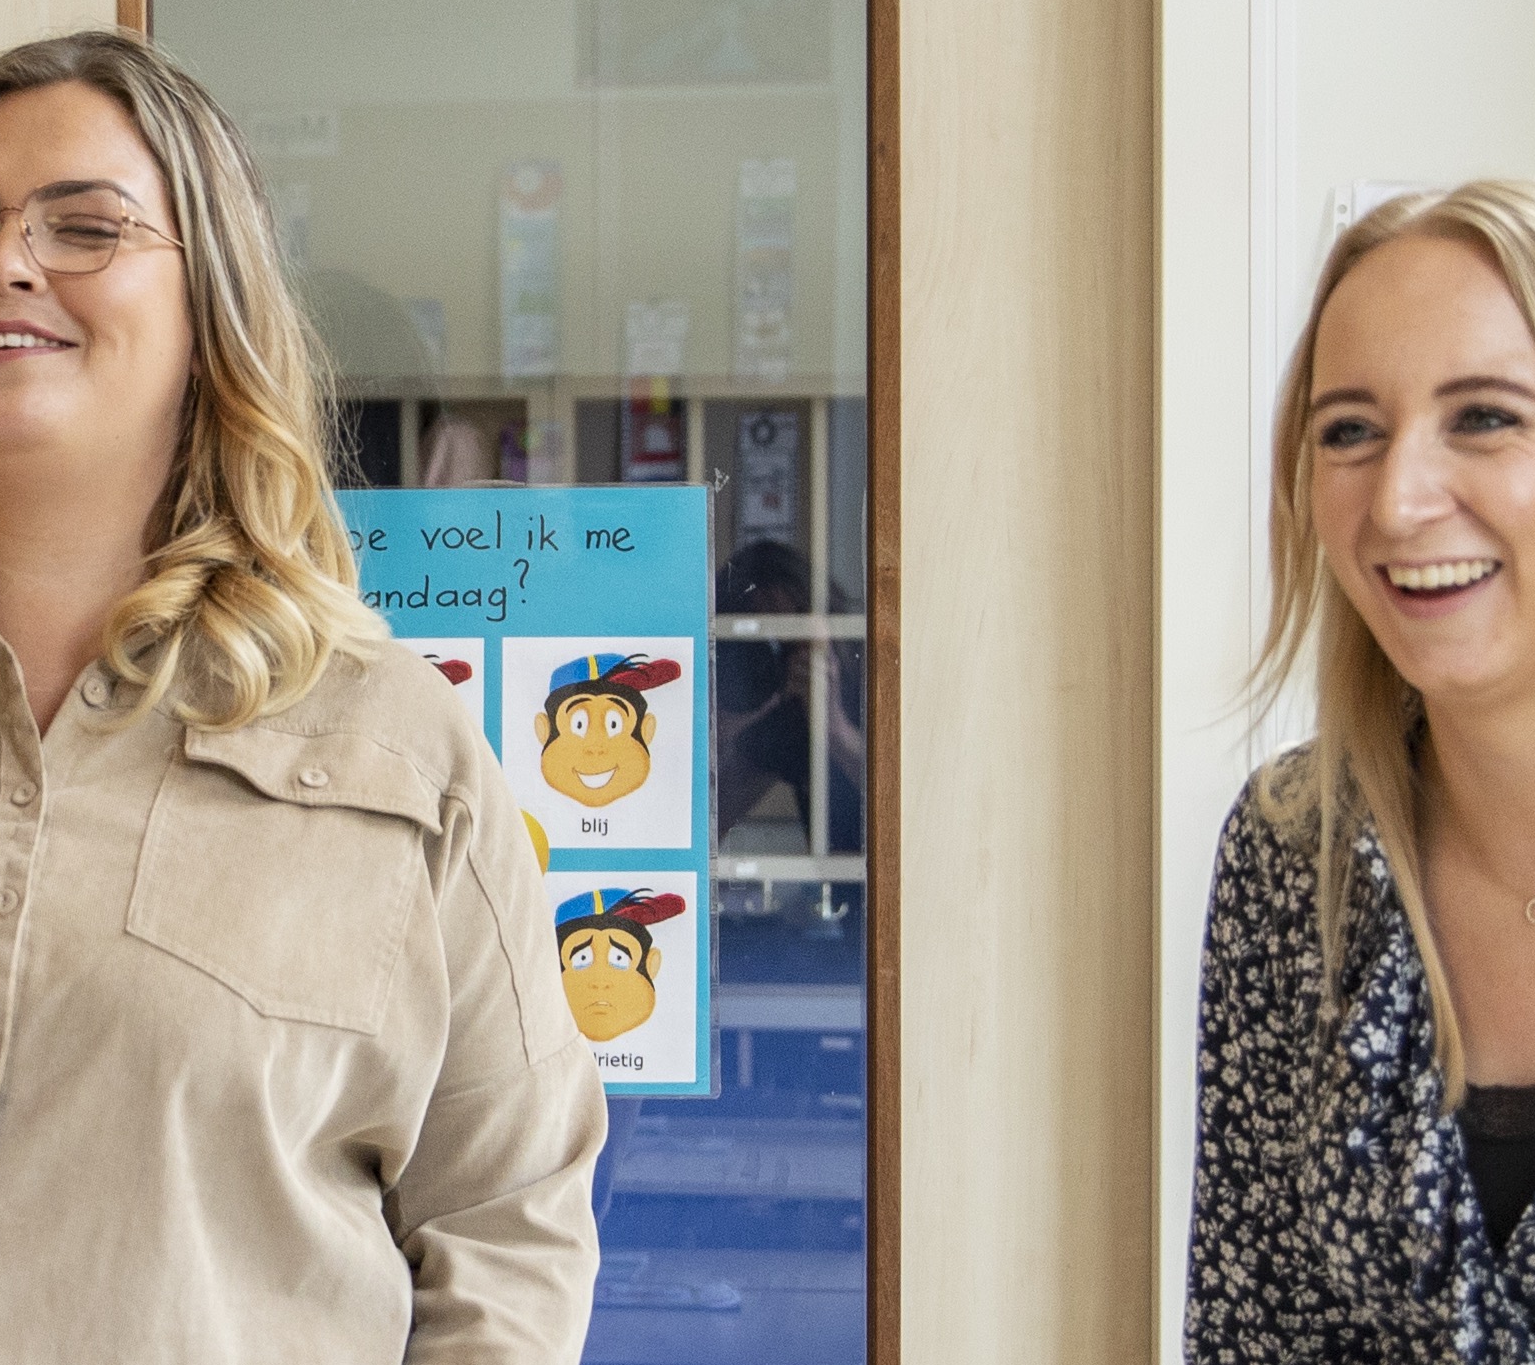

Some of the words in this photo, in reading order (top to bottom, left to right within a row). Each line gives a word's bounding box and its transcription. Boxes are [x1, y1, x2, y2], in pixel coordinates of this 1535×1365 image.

[420, 509, 502, 551] voel
[527, 514, 559, 552] ik
[585, 527, 635, 552] me
[581, 817, 609, 837] blij
